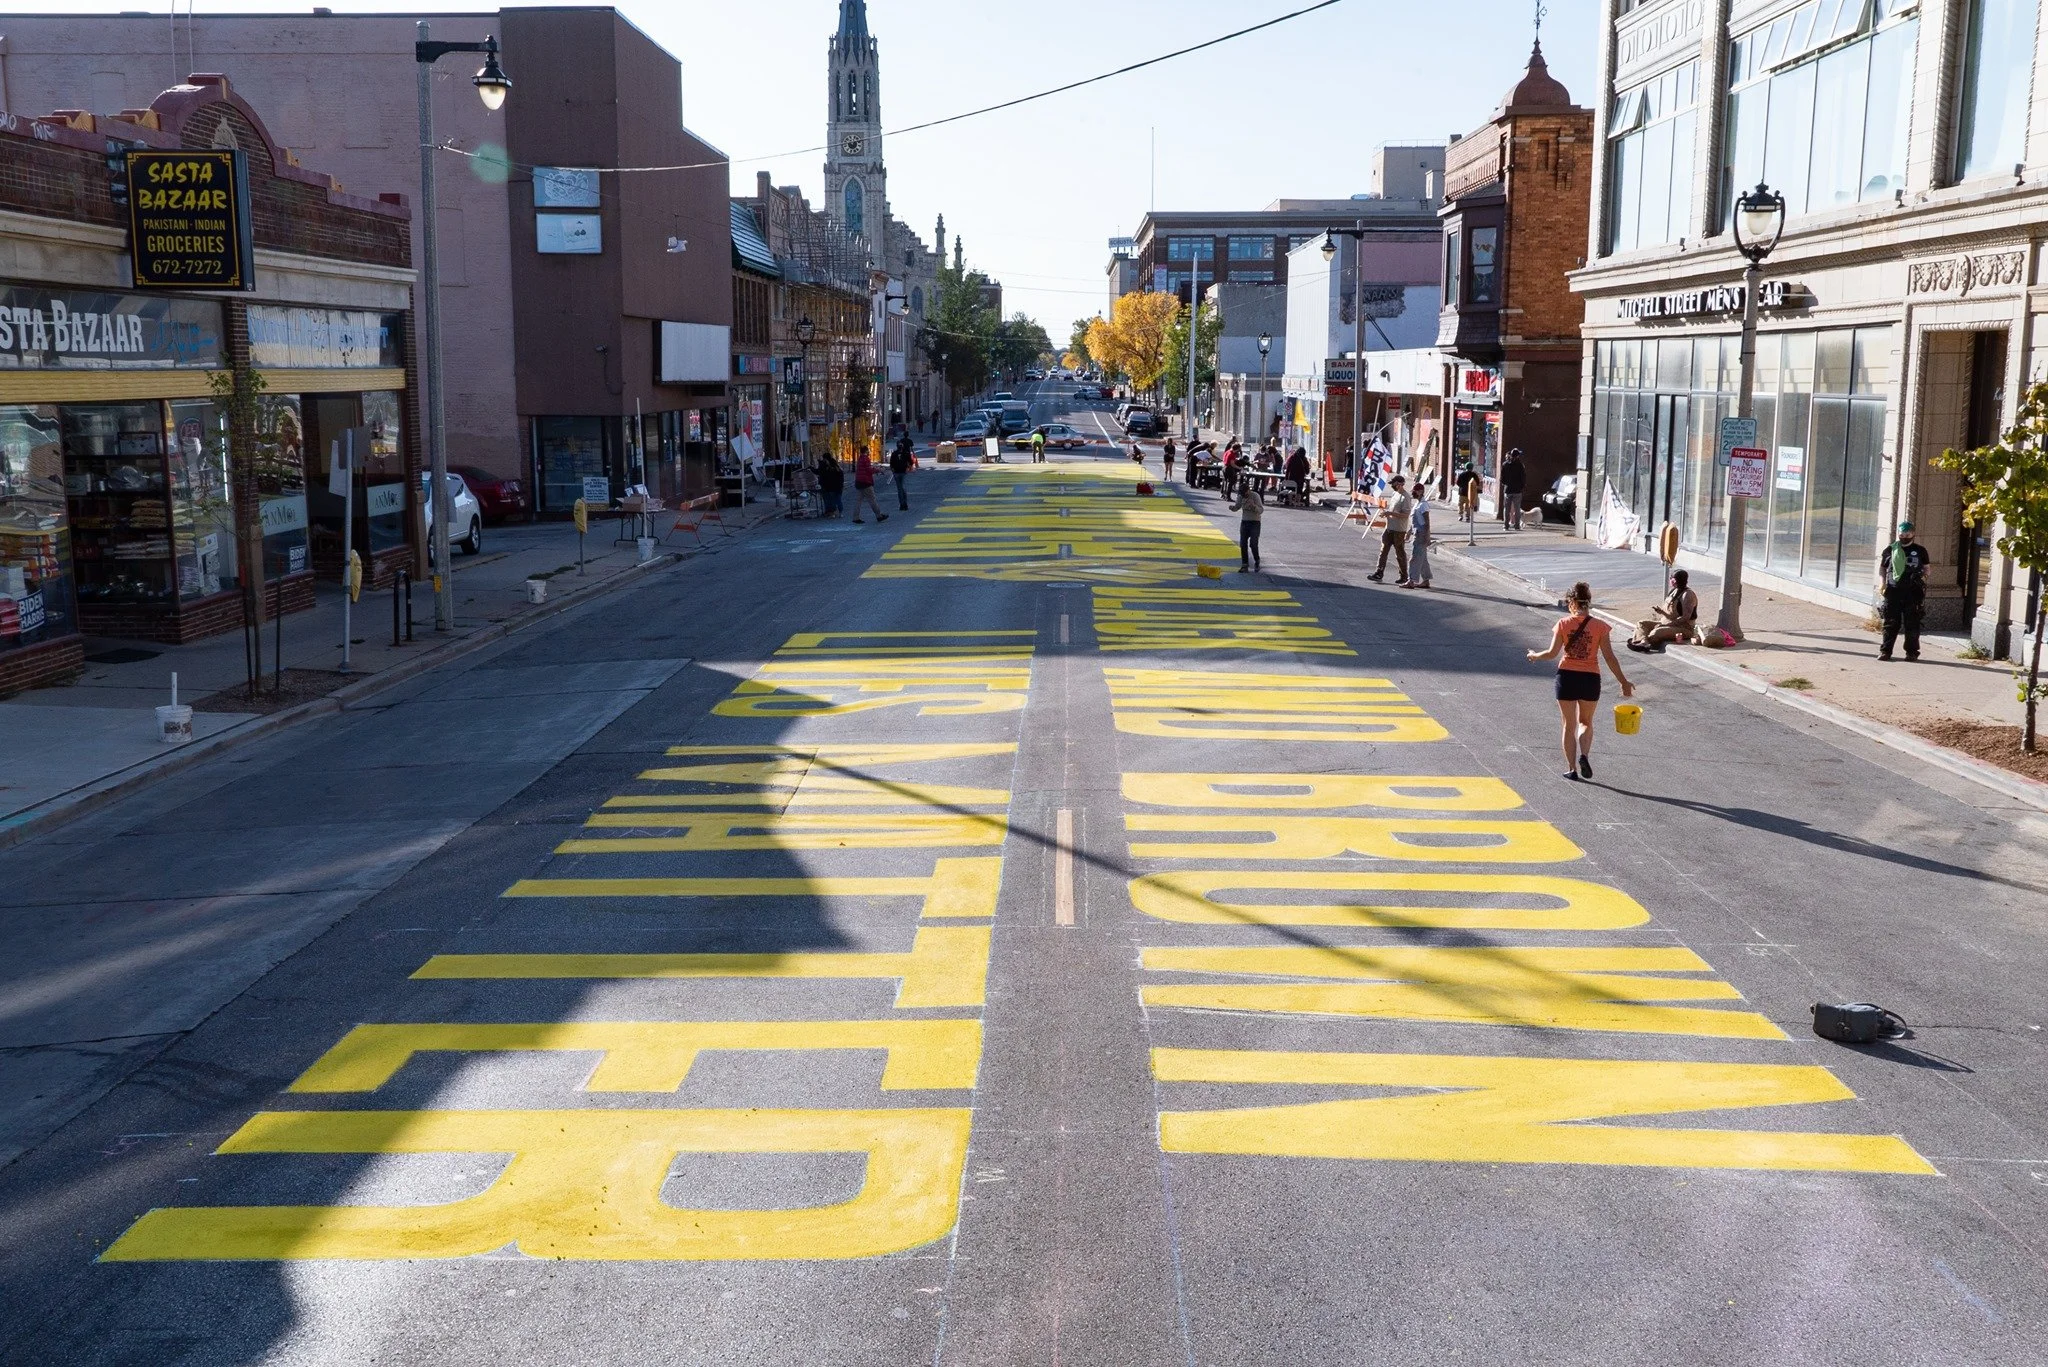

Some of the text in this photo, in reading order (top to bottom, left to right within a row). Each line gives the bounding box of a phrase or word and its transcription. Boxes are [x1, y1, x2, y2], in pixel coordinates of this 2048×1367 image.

[148, 162, 213, 183] SASTA
[139, 189, 227, 211] BAZAAR
[143, 219, 226, 231] PAKISTANI INDIAN
[147, 235, 225, 253] GROCERIES
[153, 260, 222, 274] 672-7272
[1617, 296, 1662, 318] MITCHELL
[1664, 290, 1704, 316] STREET
[1758, 282, 1783, 307] EAR
[51, 299, 145, 352] BAZAAR
[1327, 370, 1356, 380] LIQUO
[1723, 420, 1729, 430] 2
[1723, 440, 1729, 450] 2
[1734, 450, 1763, 458] TEMPORARY
[1731, 465, 1763, 475] PARKING
[1743, 459, 1753, 467] NO
[19, 592, 44, 616] BIDEN
[1092, 586, 1359, 656] BLACK
[710, 630, 1037, 718] LIVES
[1102, 668, 1450, 743] AND
[1121, 773, 1943, 1177] BROWN
[96, 742, 1018, 1264] MATTER
